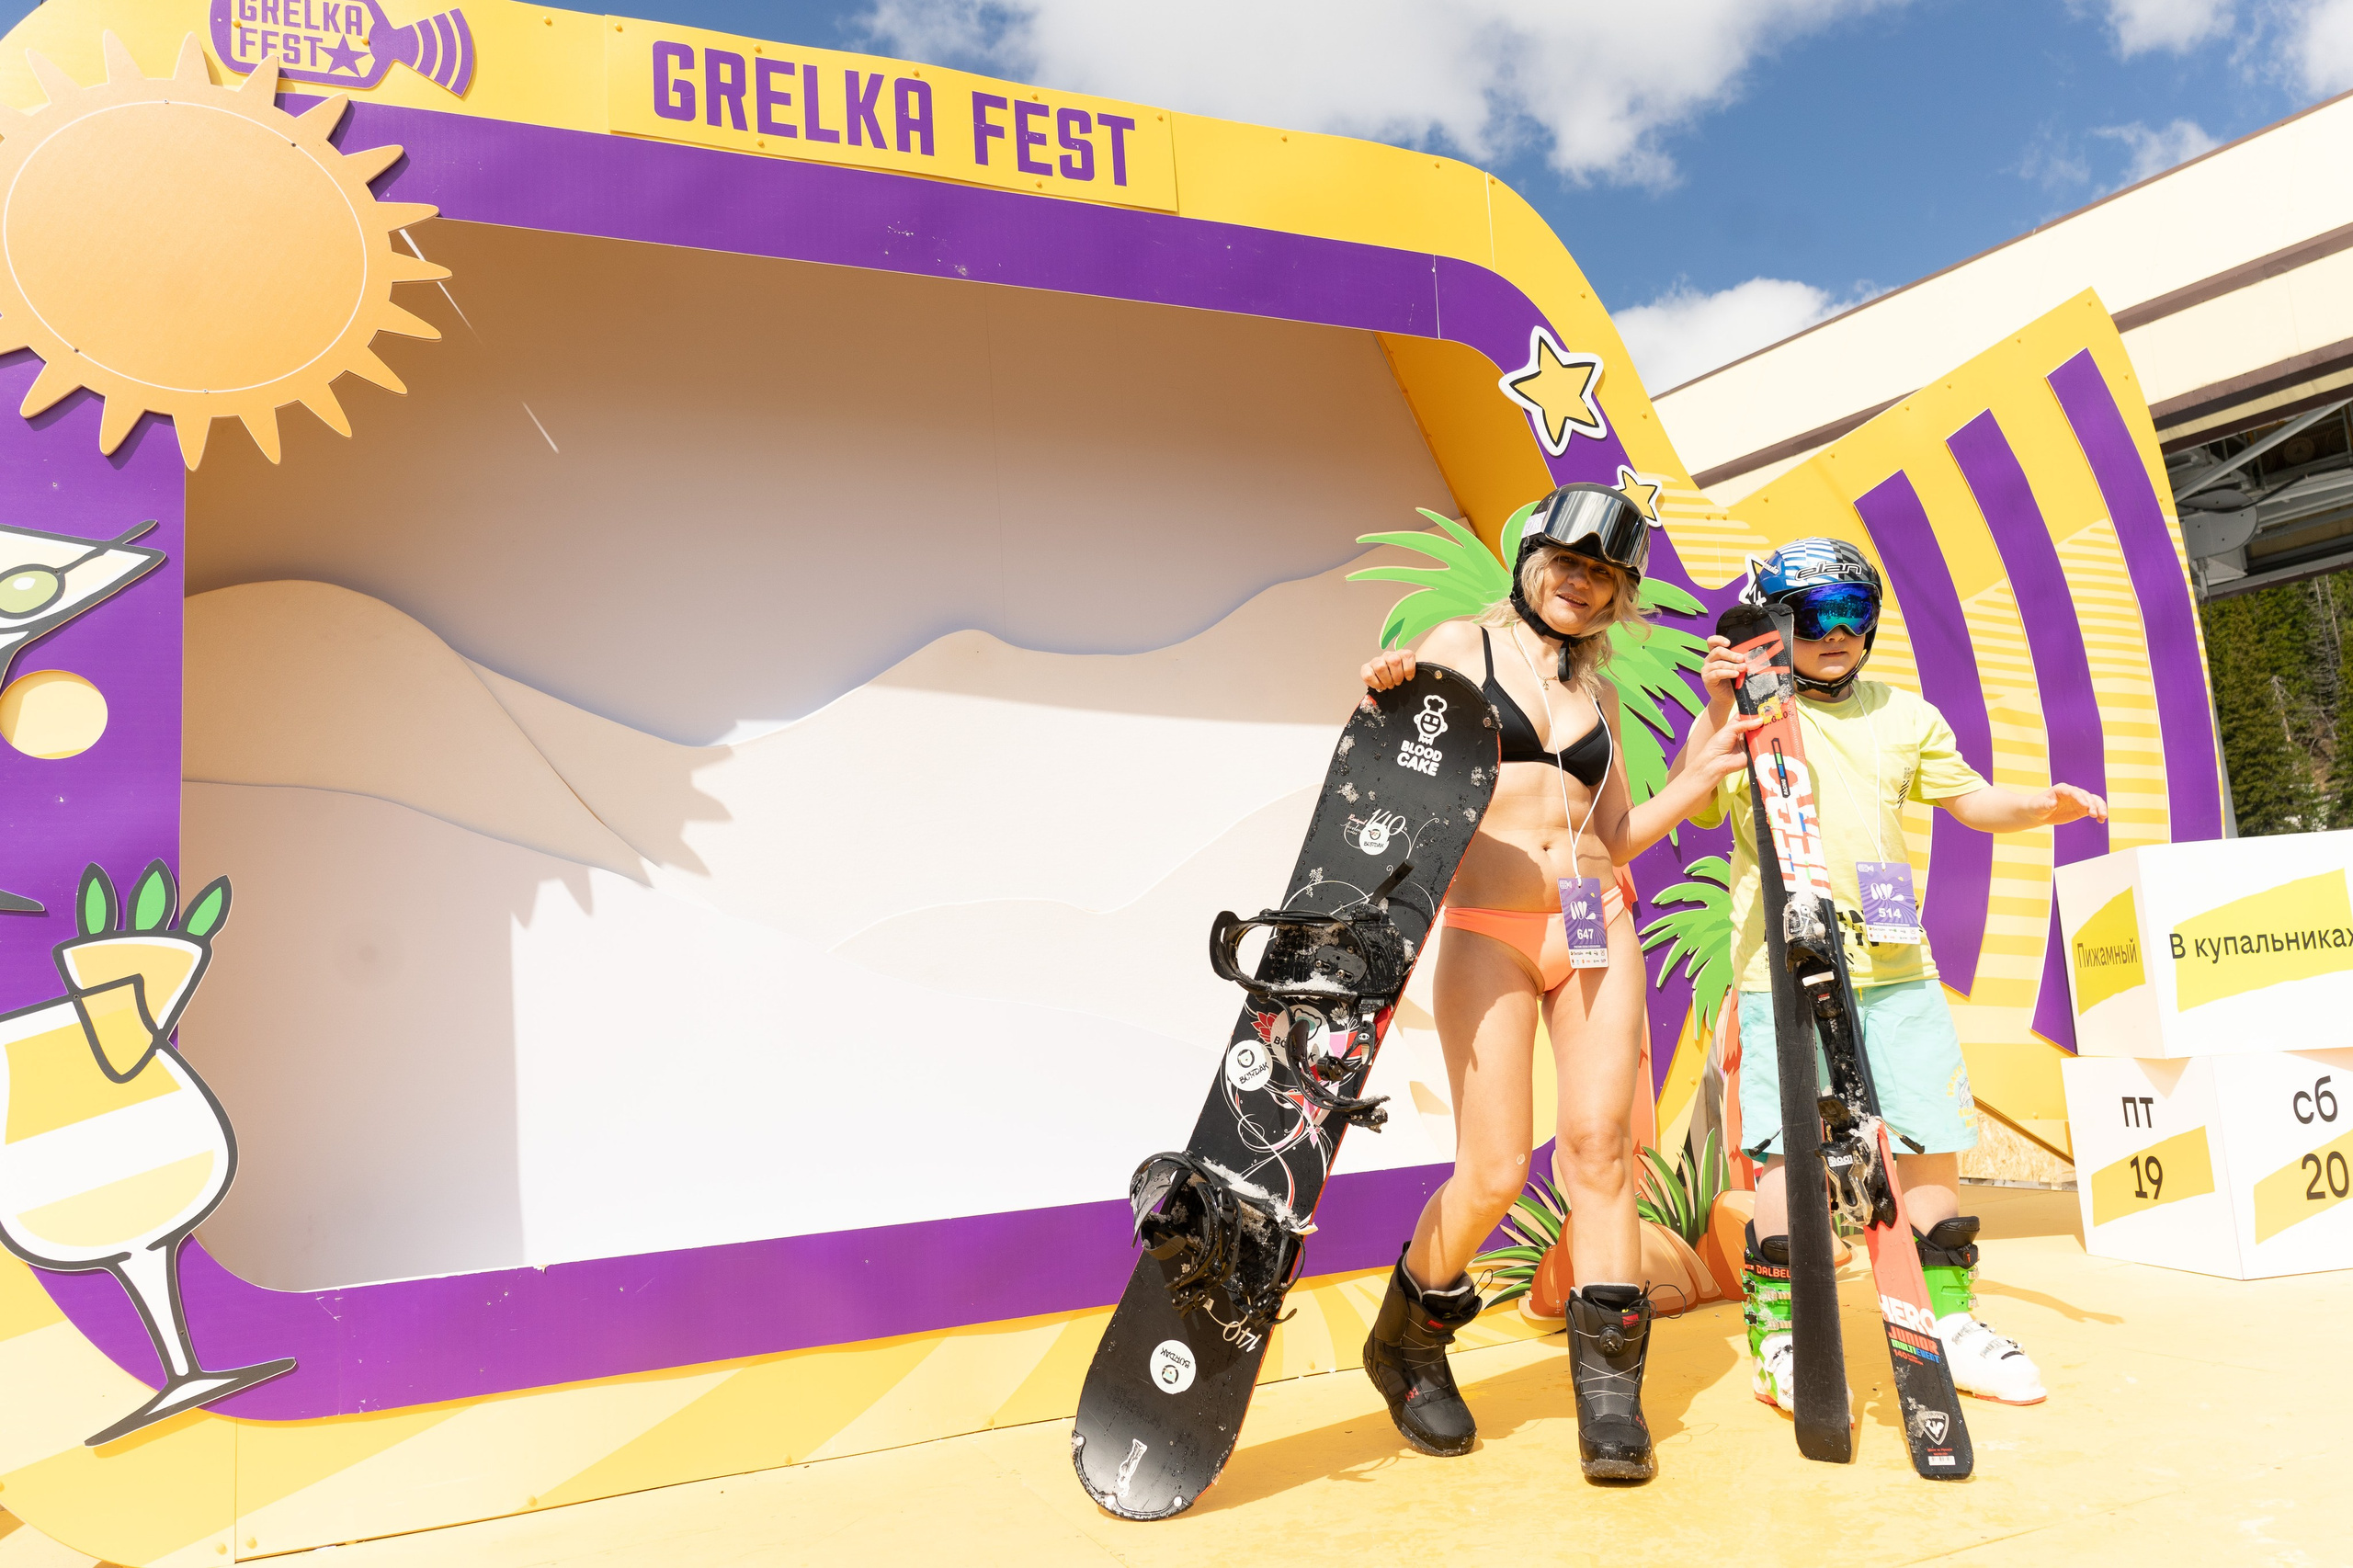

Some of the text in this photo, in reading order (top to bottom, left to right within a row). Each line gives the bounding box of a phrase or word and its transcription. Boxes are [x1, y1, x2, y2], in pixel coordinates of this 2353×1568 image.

[239, 0, 362, 36] GRELKA
[239, 27, 324, 67] FEST
[653, 40, 1135, 187] GRELKA FEST
[1795, 562, 1862, 581] elan
[1397, 752, 1439, 777] CAKE
[1401, 740, 1443, 762] BLOOD
[1878, 907, 1902, 919] 514
[1576, 928, 1594, 940] 647
[2169, 933, 2187, 959] В
[2077, 937, 2138, 968] Пижамный
[2121, 1096, 2154, 1129] пт
[2293, 1075, 2338, 1125] сб
[2130, 1155, 2164, 1200] 19
[2302, 1151, 2350, 1200] 20
[1877, 1290, 1941, 1339] HERO
[1222, 1321, 1262, 1352] 140
[1888, 1325, 1940, 1356] JUNIOR
